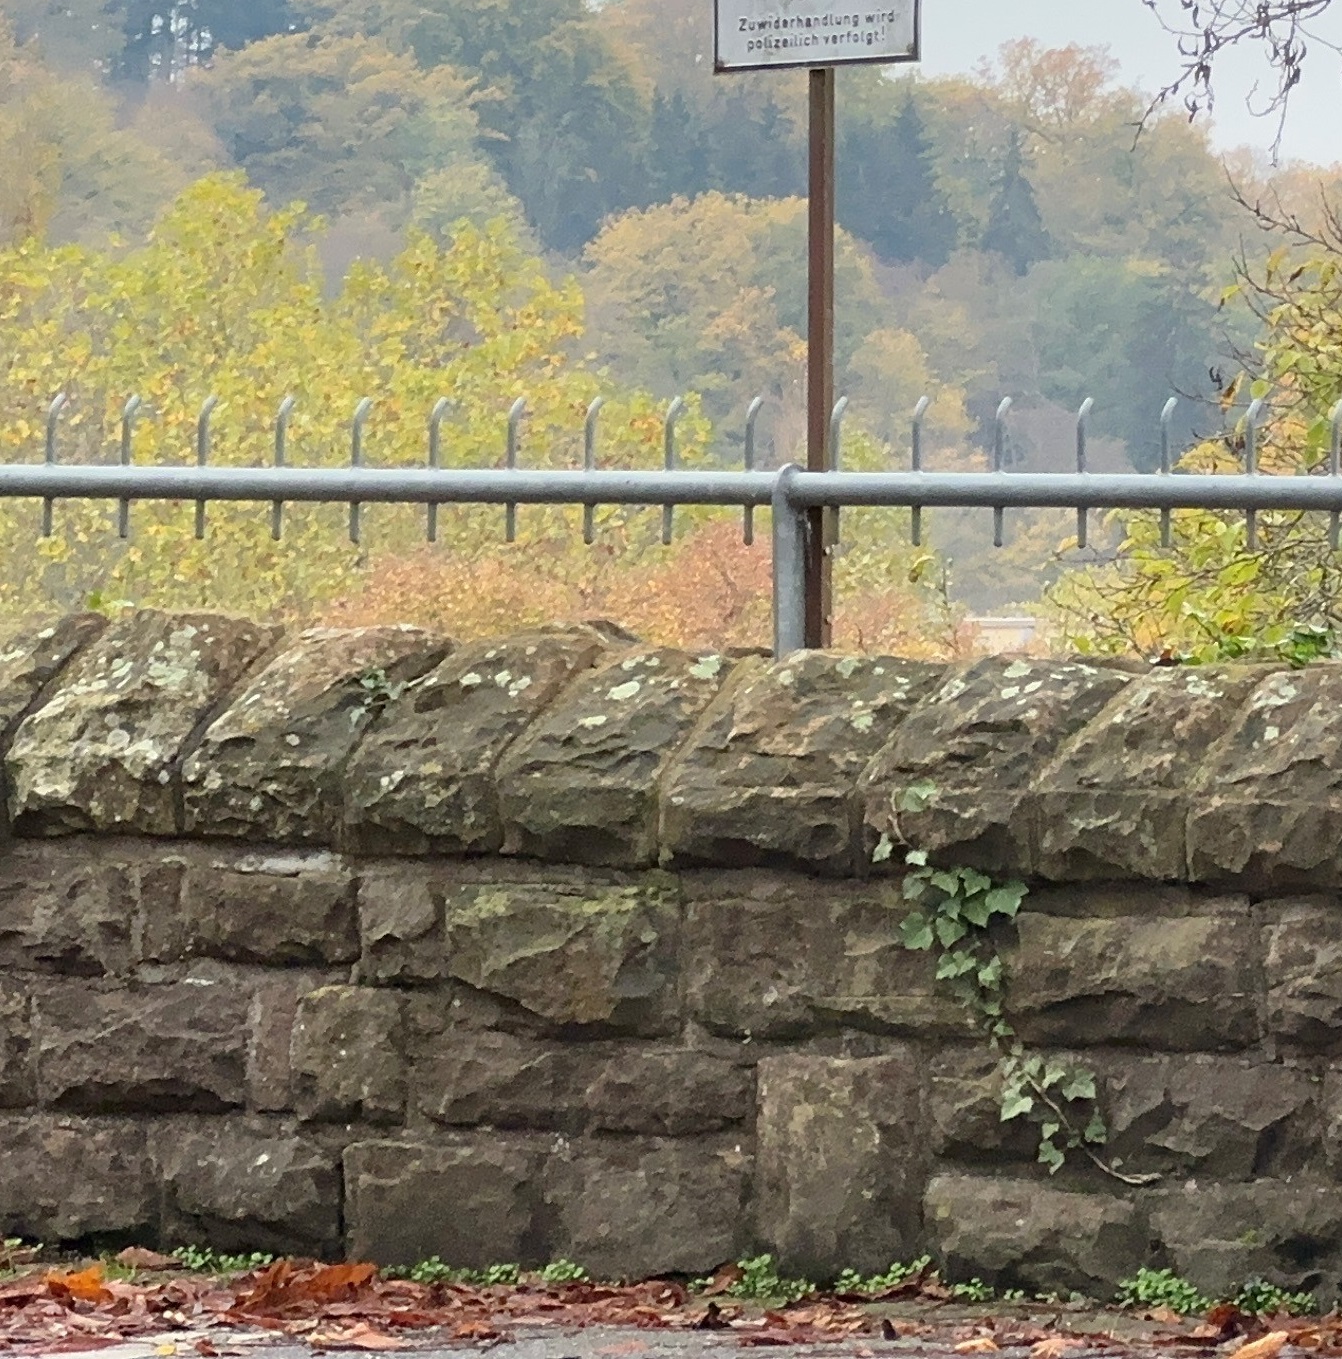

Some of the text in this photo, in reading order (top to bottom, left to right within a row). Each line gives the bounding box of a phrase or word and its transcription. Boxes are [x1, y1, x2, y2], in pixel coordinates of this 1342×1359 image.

[738, 9, 895, 32] Zuwiderhandlung wird
[746, 25, 886, 53] polizeilich verfolgt!
